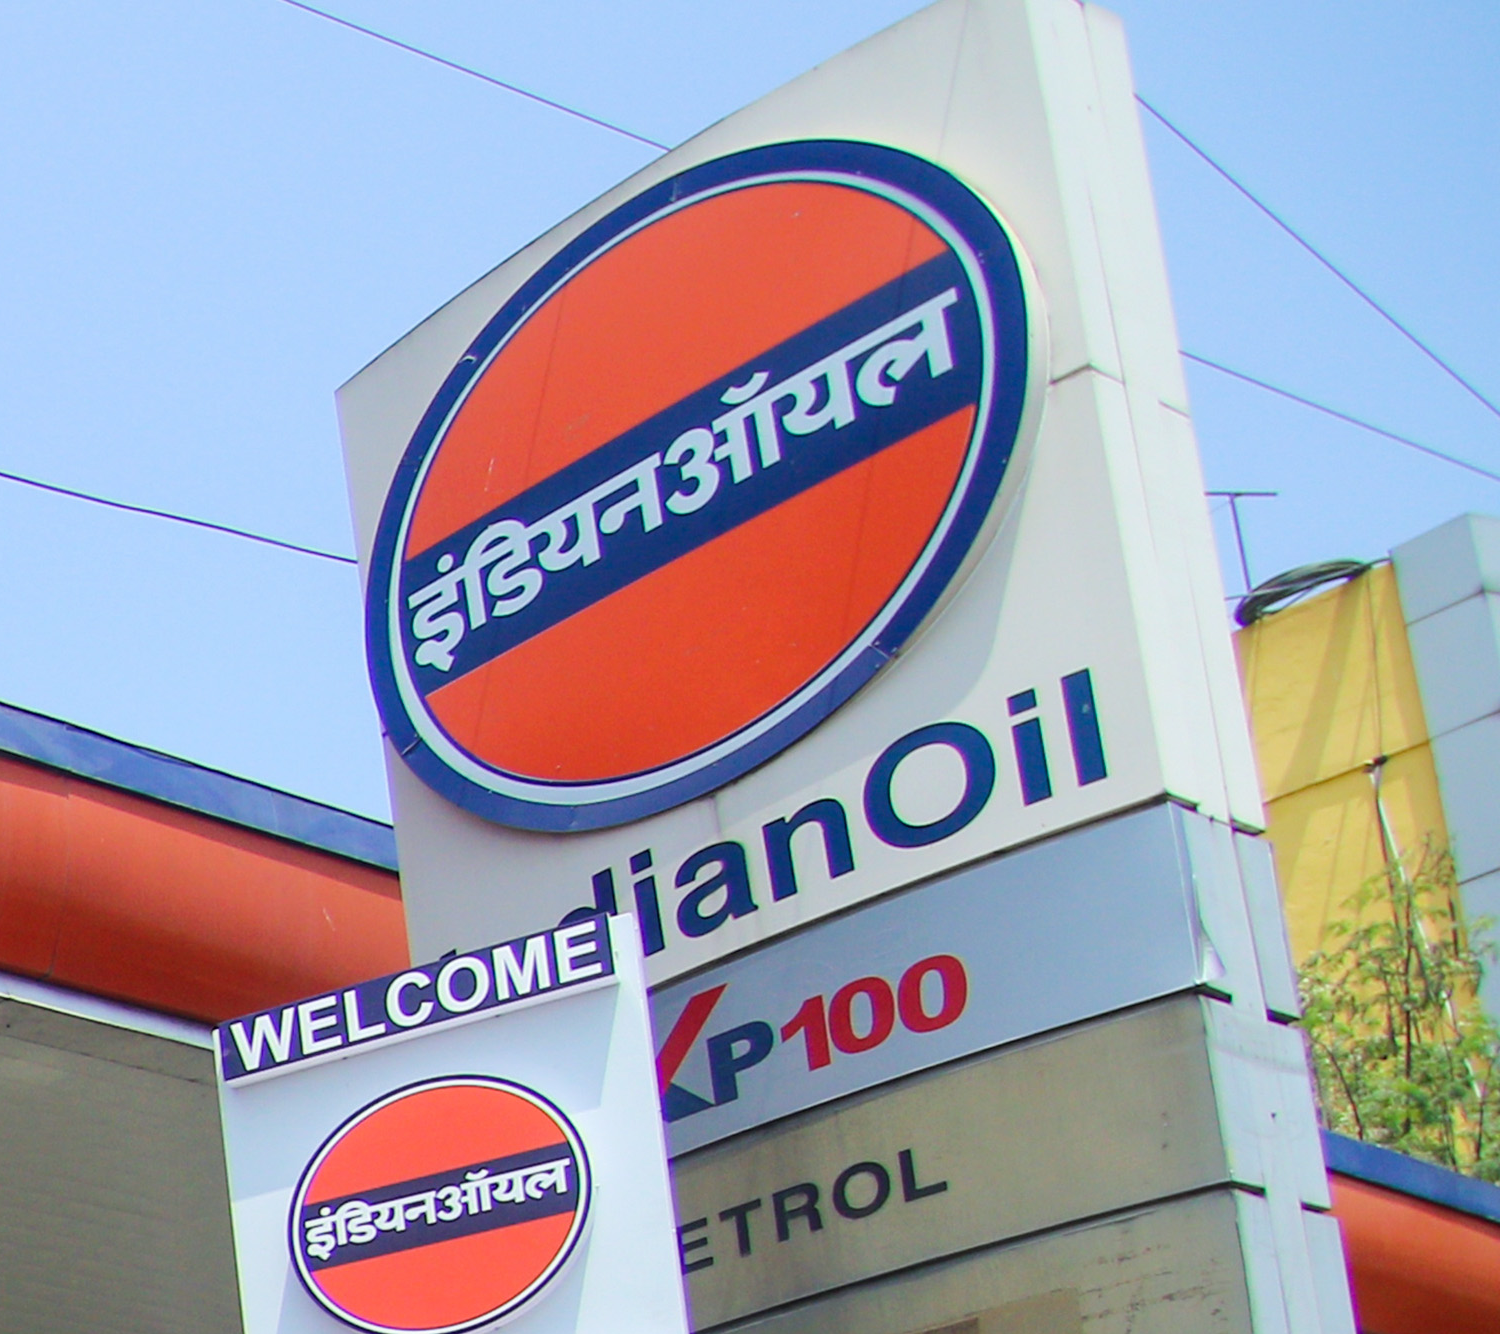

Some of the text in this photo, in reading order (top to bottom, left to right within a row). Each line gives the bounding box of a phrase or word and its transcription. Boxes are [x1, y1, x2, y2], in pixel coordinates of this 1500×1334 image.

[407, 288, 960, 672] इंडियनऑयल
[230, 920, 602, 1071] WELCOME
[305, 1155, 571, 1260] इंडियनऑयल
[678, 1148, 948, 1275] ETROL
